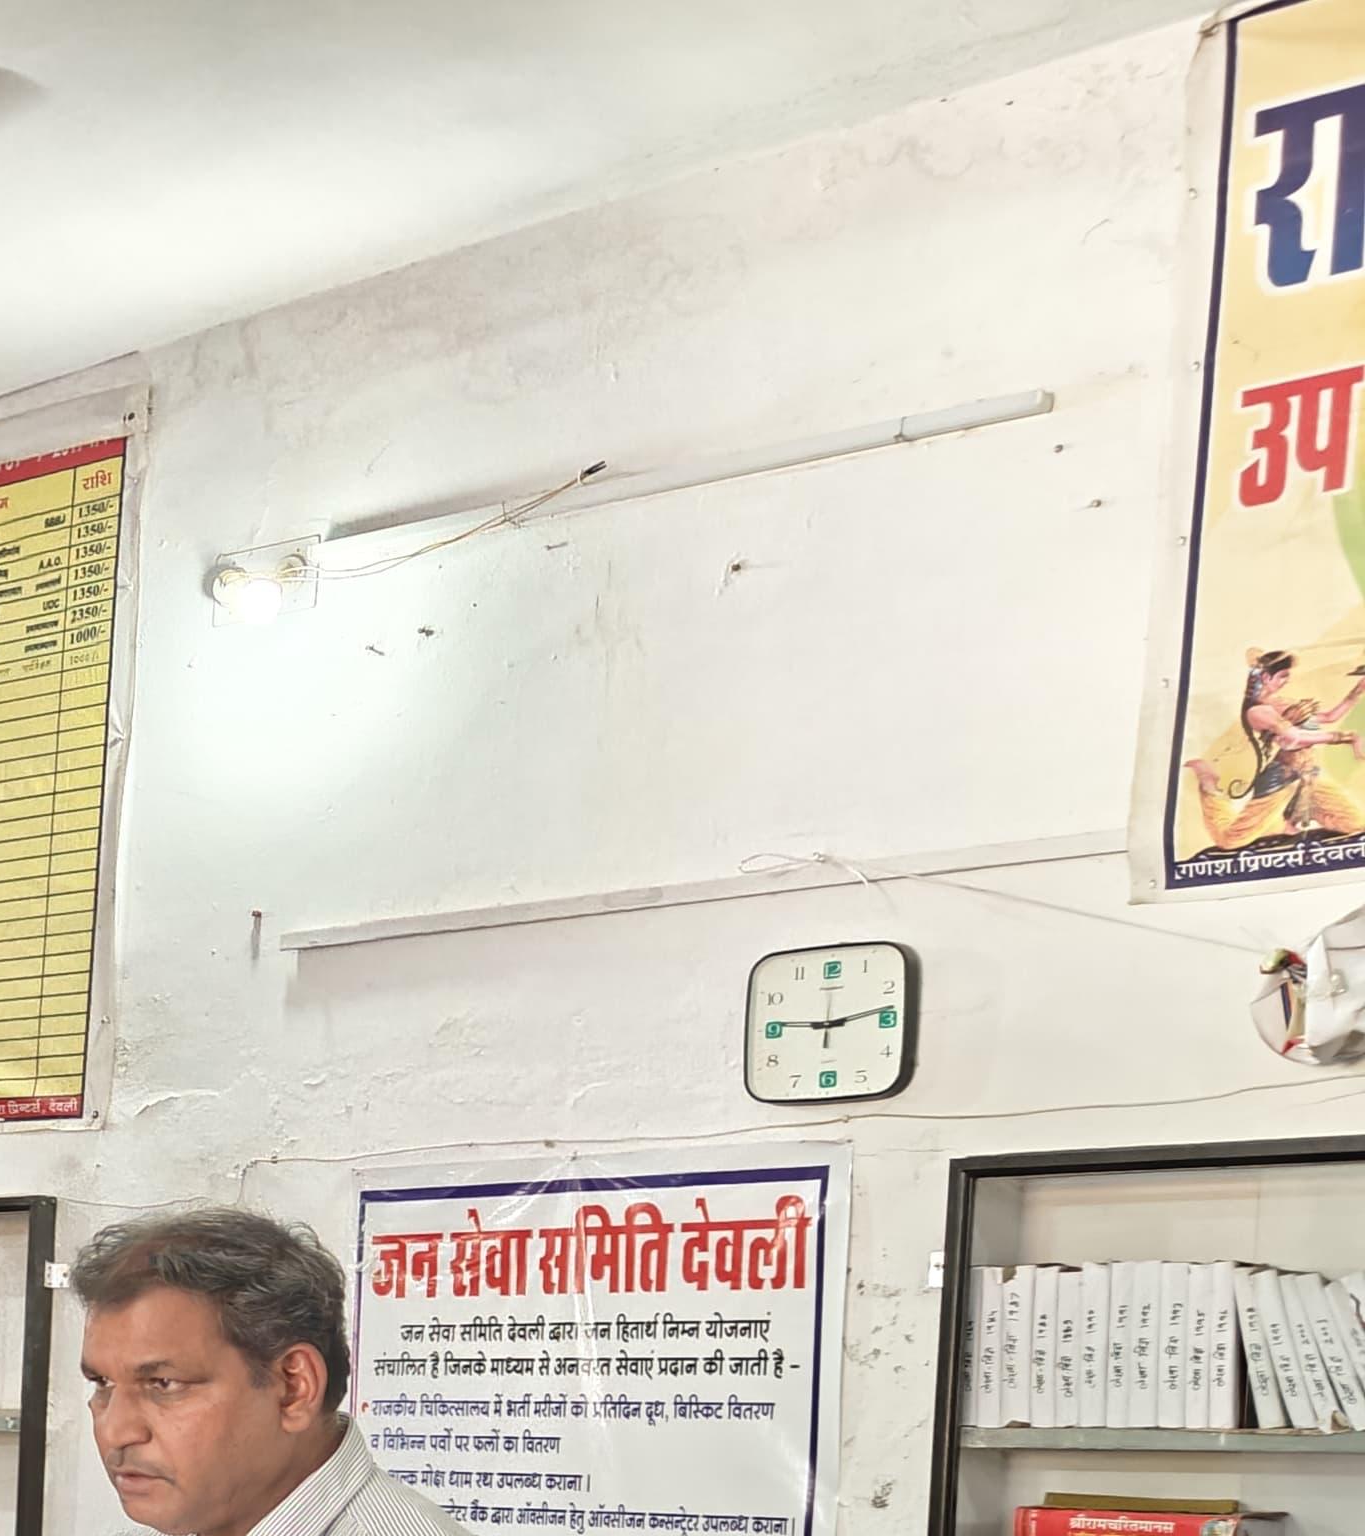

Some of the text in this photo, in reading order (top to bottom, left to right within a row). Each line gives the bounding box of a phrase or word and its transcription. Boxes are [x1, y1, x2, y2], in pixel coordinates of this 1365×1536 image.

[82, 470, 113, 491] राशि
[371, 1195, 814, 1299] जन सेवा समिति देवली
[400, 1324, 426, 1343] जन
[429, 1316, 456, 1343] सेवा
[460, 1315, 503, 1343] समिति
[507, 1314, 546, 1343] देवली
[616, 1312, 660, 1343] हितार्थ
[663, 1312, 701, 1340] निम्न
[705, 1311, 772, 1343] योजनाएं
[373, 1348, 785, 1380] संचालित है जिनके माध्यम से सेवाएं प्रदान की जाती है
[371, 1393, 418, 1418] राजकीय
[420, 1392, 491, 1418] चिकित्सालय
[673, 1394, 724, 1420] बिस्किट
[727, 1394, 776, 1420] वितरण
[383, 1427, 562, 1454] विभिन्न फलों वितरण
[449, 1469, 543, 1491] धाम रथ उपलब्ध
[569, 1502, 586, 1535] हेतु
